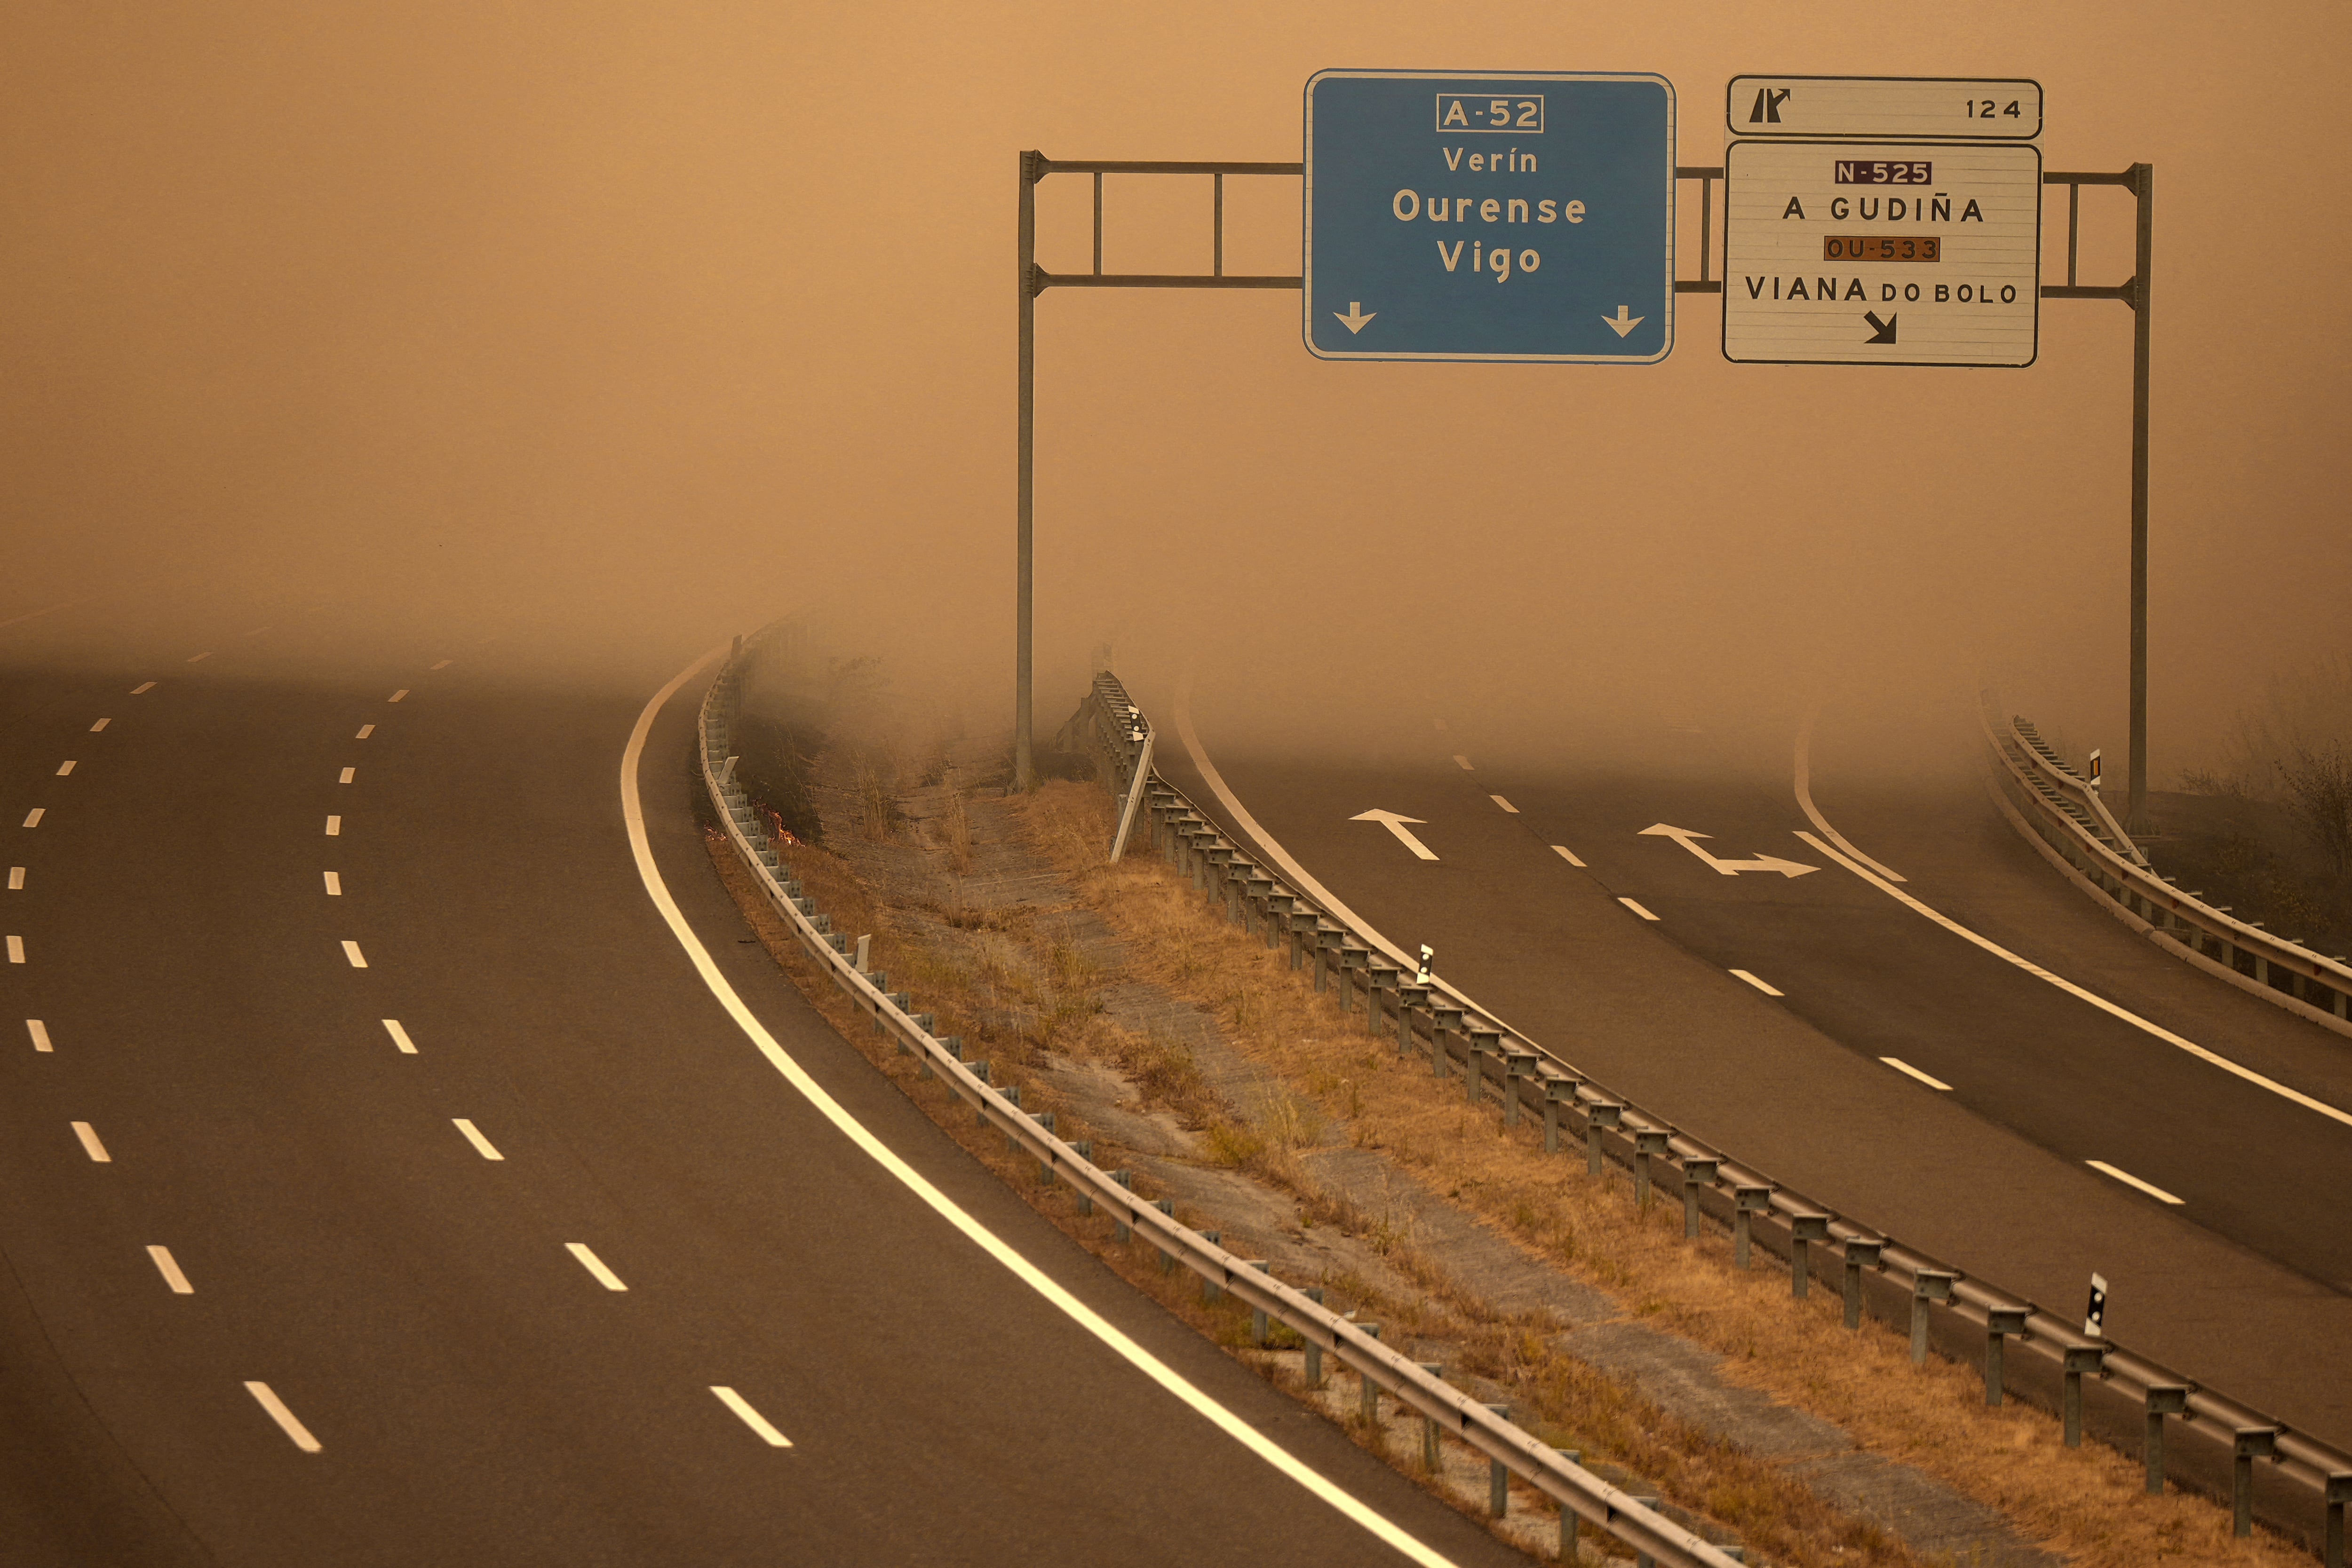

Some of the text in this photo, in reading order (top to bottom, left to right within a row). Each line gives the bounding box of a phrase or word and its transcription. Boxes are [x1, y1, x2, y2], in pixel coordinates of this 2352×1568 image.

[1443, 100, 1538, 127] A-52
[1967, 100, 2020, 119] 124
[1442, 147, 1538, 172] Verín
[1837, 163, 1928, 183] N-525
[1393, 189, 1586, 223] Ourense
[1782, 192, 1984, 222] A GUDIÑA
[1437, 240, 1541, 284] Vigo
[1828, 239, 1937, 259] OU-533
[1745, 276, 2016, 303] VIANA DO BOLO
